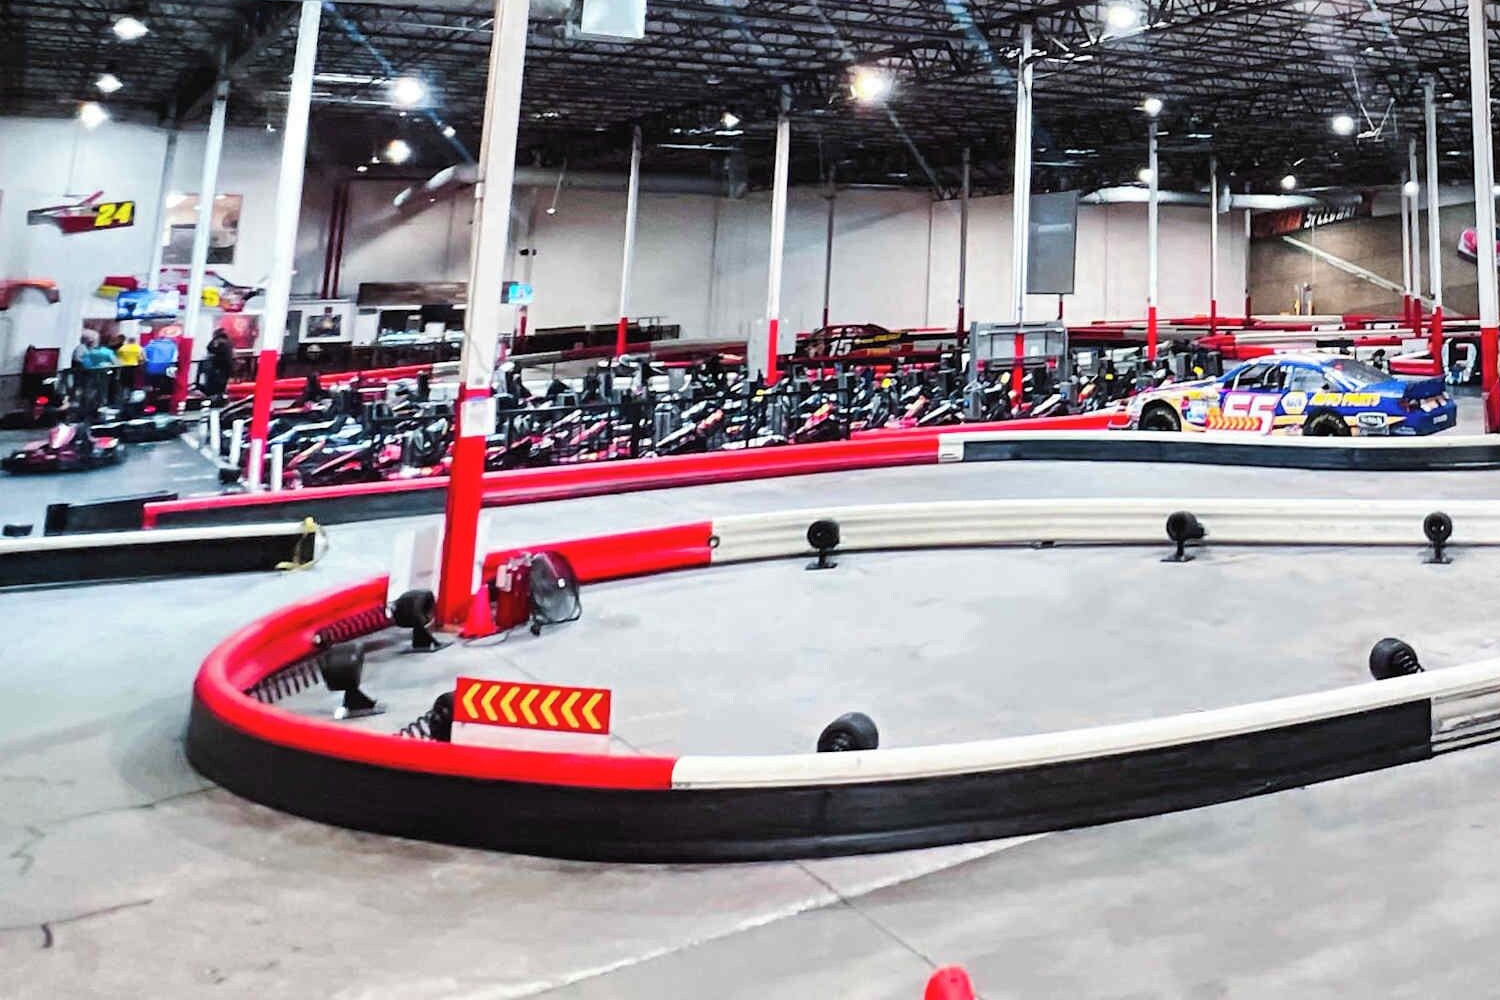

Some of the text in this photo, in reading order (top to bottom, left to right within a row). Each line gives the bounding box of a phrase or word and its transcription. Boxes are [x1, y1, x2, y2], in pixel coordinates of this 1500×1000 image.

[94, 203, 132, 226] 24
[829, 339, 852, 357] 15
[1223, 392, 1281, 435] 55
